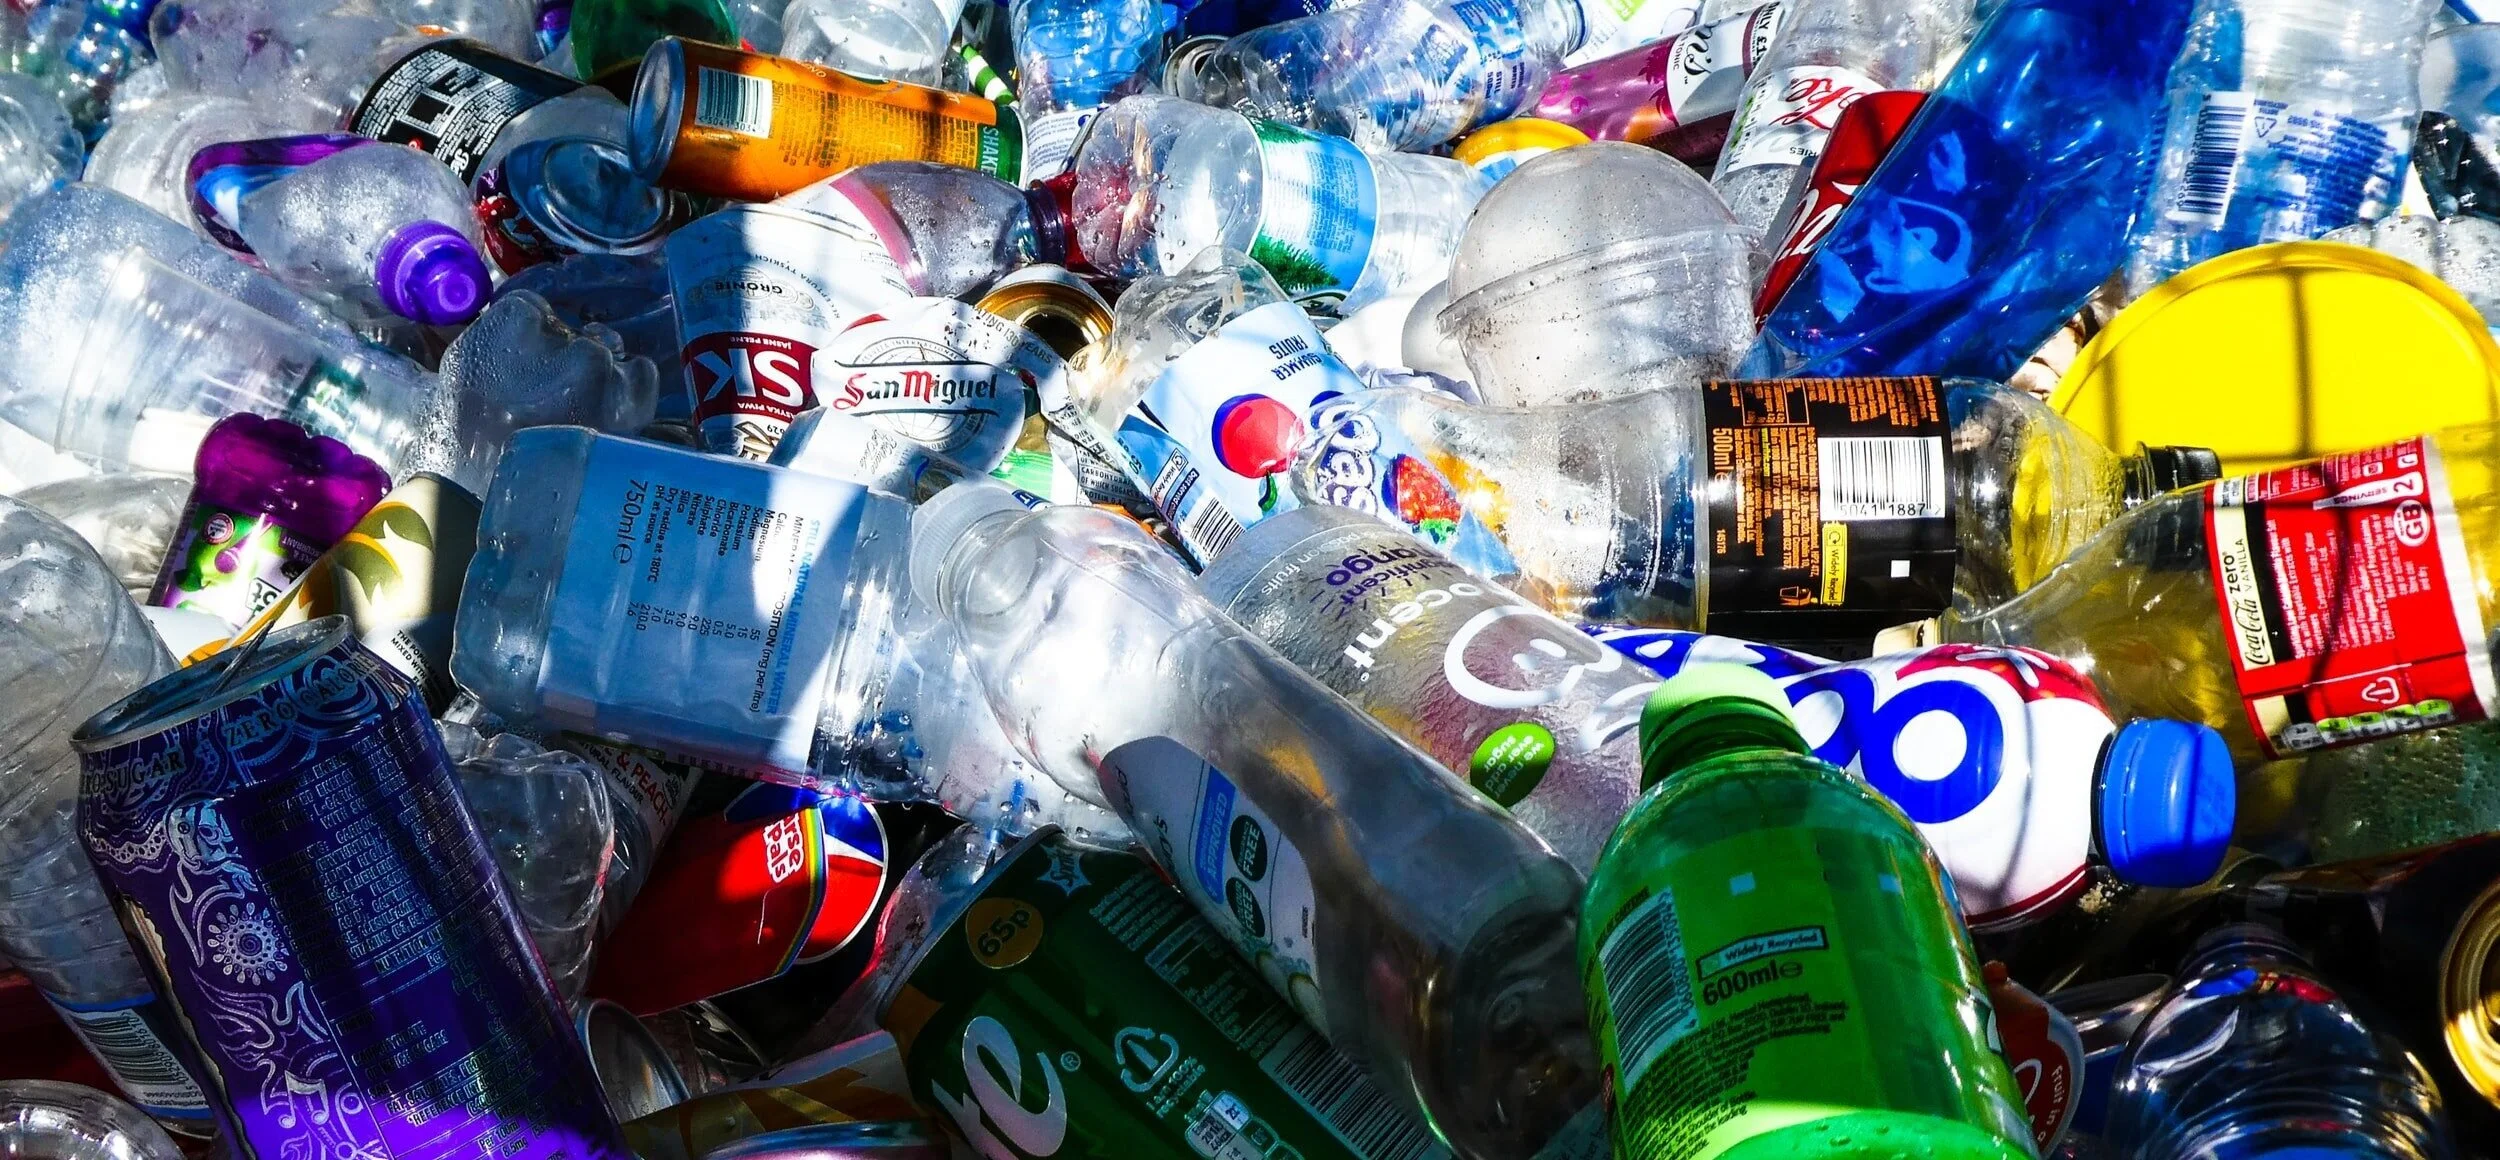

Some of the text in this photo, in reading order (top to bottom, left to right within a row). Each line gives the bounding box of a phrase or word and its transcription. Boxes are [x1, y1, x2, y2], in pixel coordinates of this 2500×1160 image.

[1790, 146, 1819, 157] RIES
[754, 253, 797, 275] TYSKICH
[1020, 341, 1054, 364] YEARS
[1268, 334, 1309, 360] FRUITS
[1270, 351, 1323, 381] SUMMER
[737, 402, 766, 411] PIWA
[1713, 428, 1734, 470] 500ml
[655, 484, 666, 499] pH
[664, 487, 679, 503] Dry
[1173, 483, 1188, 506] served
[2393, 478, 2414, 494] 2
[676, 490, 691, 514] Silica
[687, 493, 703, 526] Nitrate
[697, 495, 715, 536] Sulphate
[1889, 503, 1926, 516] 1887
[644, 513, 657, 544] source
[658, 507, 672, 541] residue
[710, 499, 727, 538] Chloride
[718, 501, 739, 557] Bicarbonate
[732, 504, 751, 551] Potassium
[747, 507, 764, 540] Sodium
[2402, 503, 2424, 540] GB
[1830, 549, 1840, 576] Widely
[2223, 554, 2242, 596] zero
[2234, 538, 2255, 590] VANILLA
[790, 550, 814, 607] NATURAL
[1261, 562, 1301, 596] fruits
[627, 600, 640, 618] 7.6
[636, 603, 651, 631] 210.0
[651, 606, 664, 623] 7.0
[663, 609, 676, 626] 3.5
[675, 612, 688, 629] 9.0
[688, 615, 700, 631] 9.0
[397, 629, 412, 646] THE
[700, 617, 712, 637] 225
[712, 620, 724, 636] 0.5
[724, 623, 737, 639] 5.0
[737, 626, 749, 639] 15
[749, 629, 761, 641] 55
[776, 608, 801, 670] MINERAL
[390, 637, 428, 679] MIXED WITH
[755, 667, 767, 689] per
[765, 669, 787, 715] WATER
[749, 690, 765, 714] litre)
[224, 700, 295, 748] ZERO
[1484, 735, 1517, 773] sugar
[1507, 735, 1534, 763] ever
[1523, 742, 1546, 761] we
[105, 750, 186, 794] SUGAR
[616, 751, 669, 827] & PEACH
[1207, 792, 1228, 878] APPROVED
[1243, 823, 1261, 876] FREE
[767, 823, 787, 879] Pals
[1243, 886, 1257, 936] FREE
[976, 908, 1033, 958] 65p
[1725, 933, 1818, 962] Widely Recycled
[1702, 959, 1778, 1007] 600ml
[2051, 1063, 2064, 1105] Fruit
